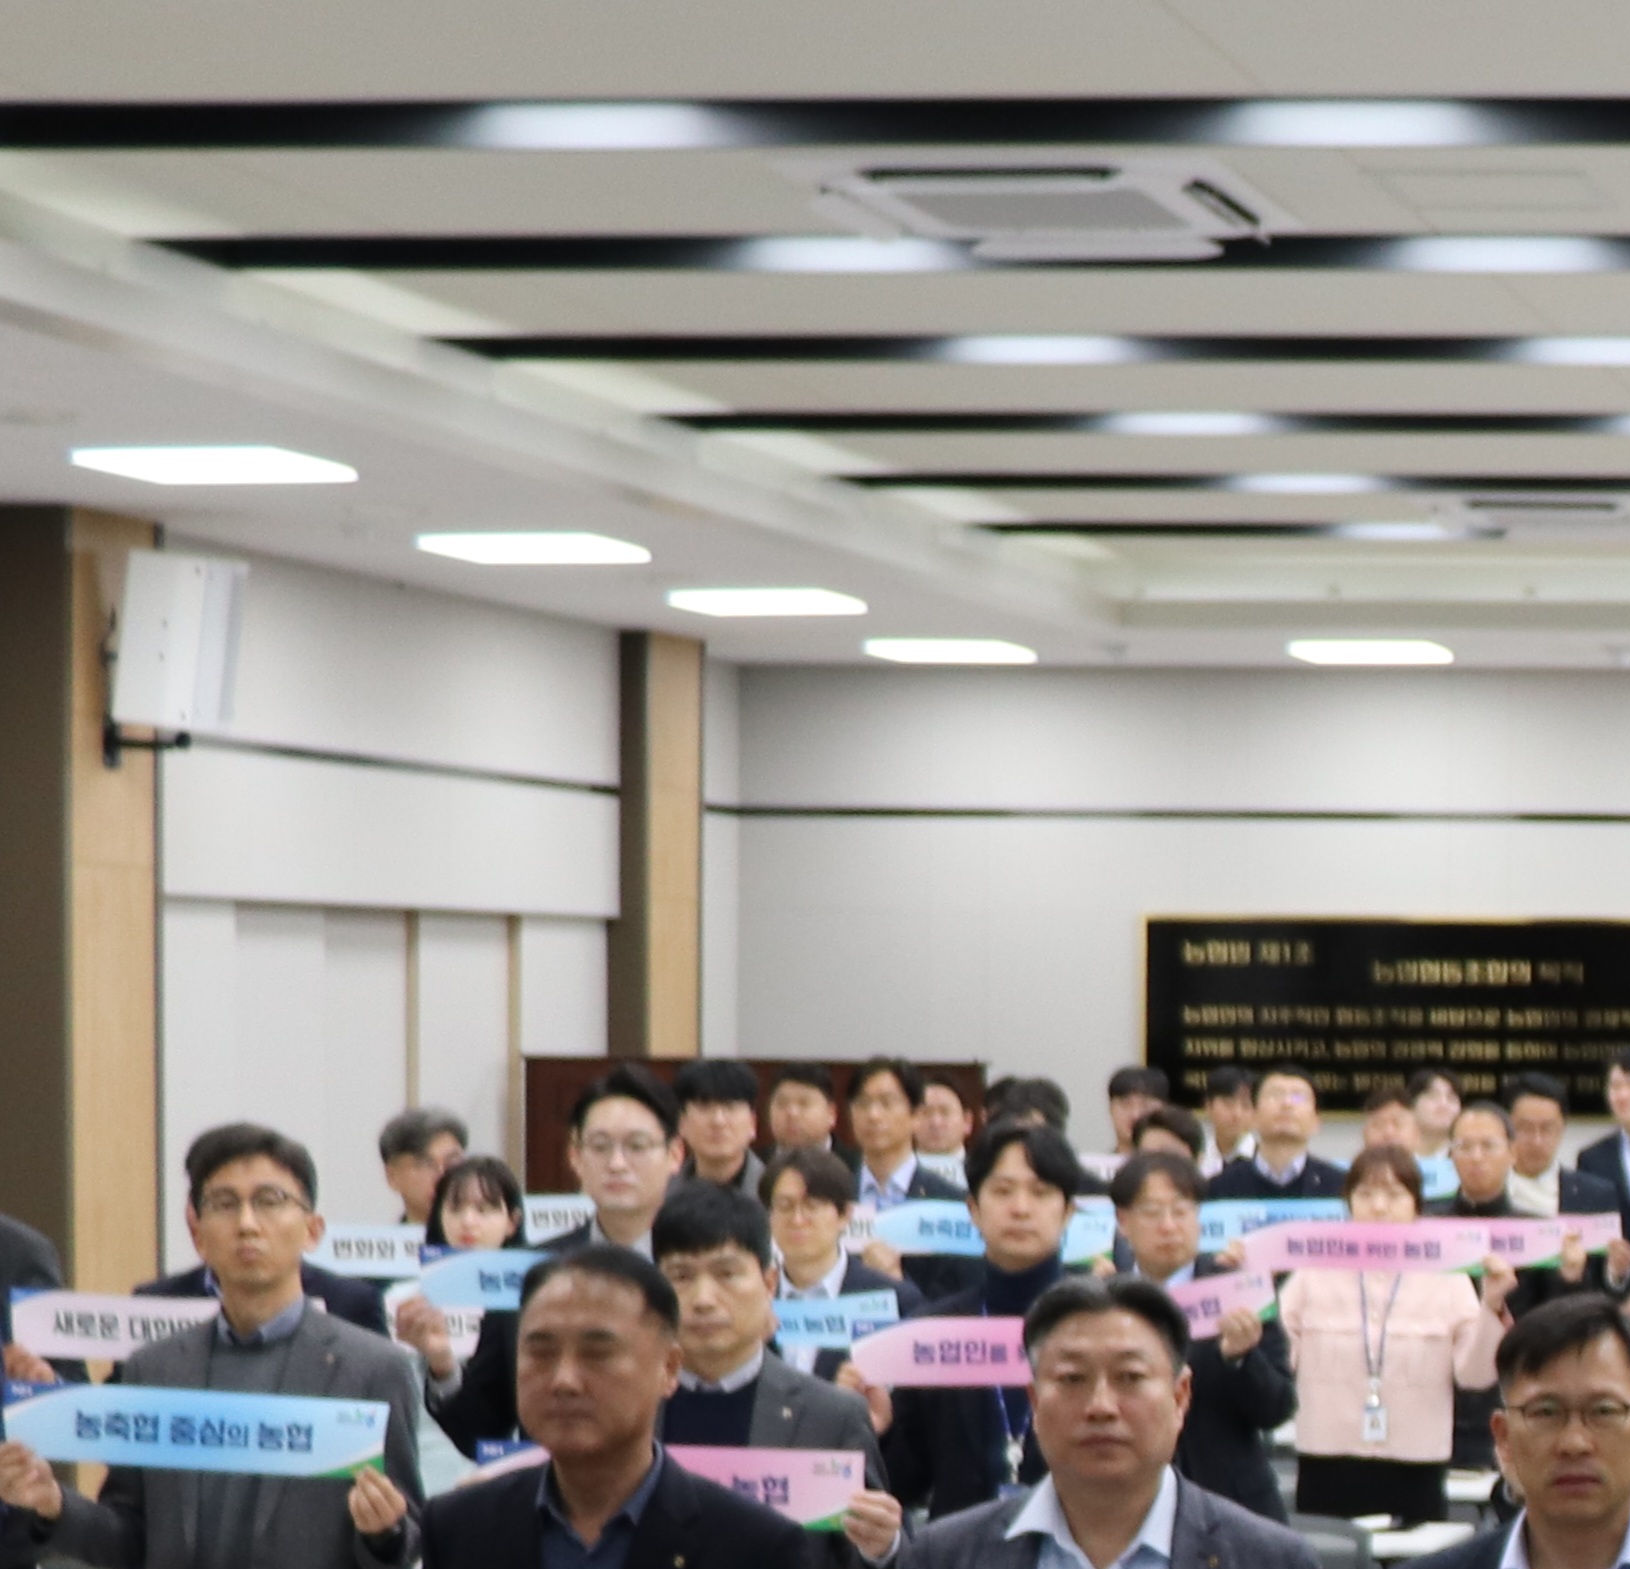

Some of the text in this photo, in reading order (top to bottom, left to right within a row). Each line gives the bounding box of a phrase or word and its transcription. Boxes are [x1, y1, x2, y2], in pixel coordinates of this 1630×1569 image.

[76, 1409, 314, 1453] 농축협 중심의 농협
